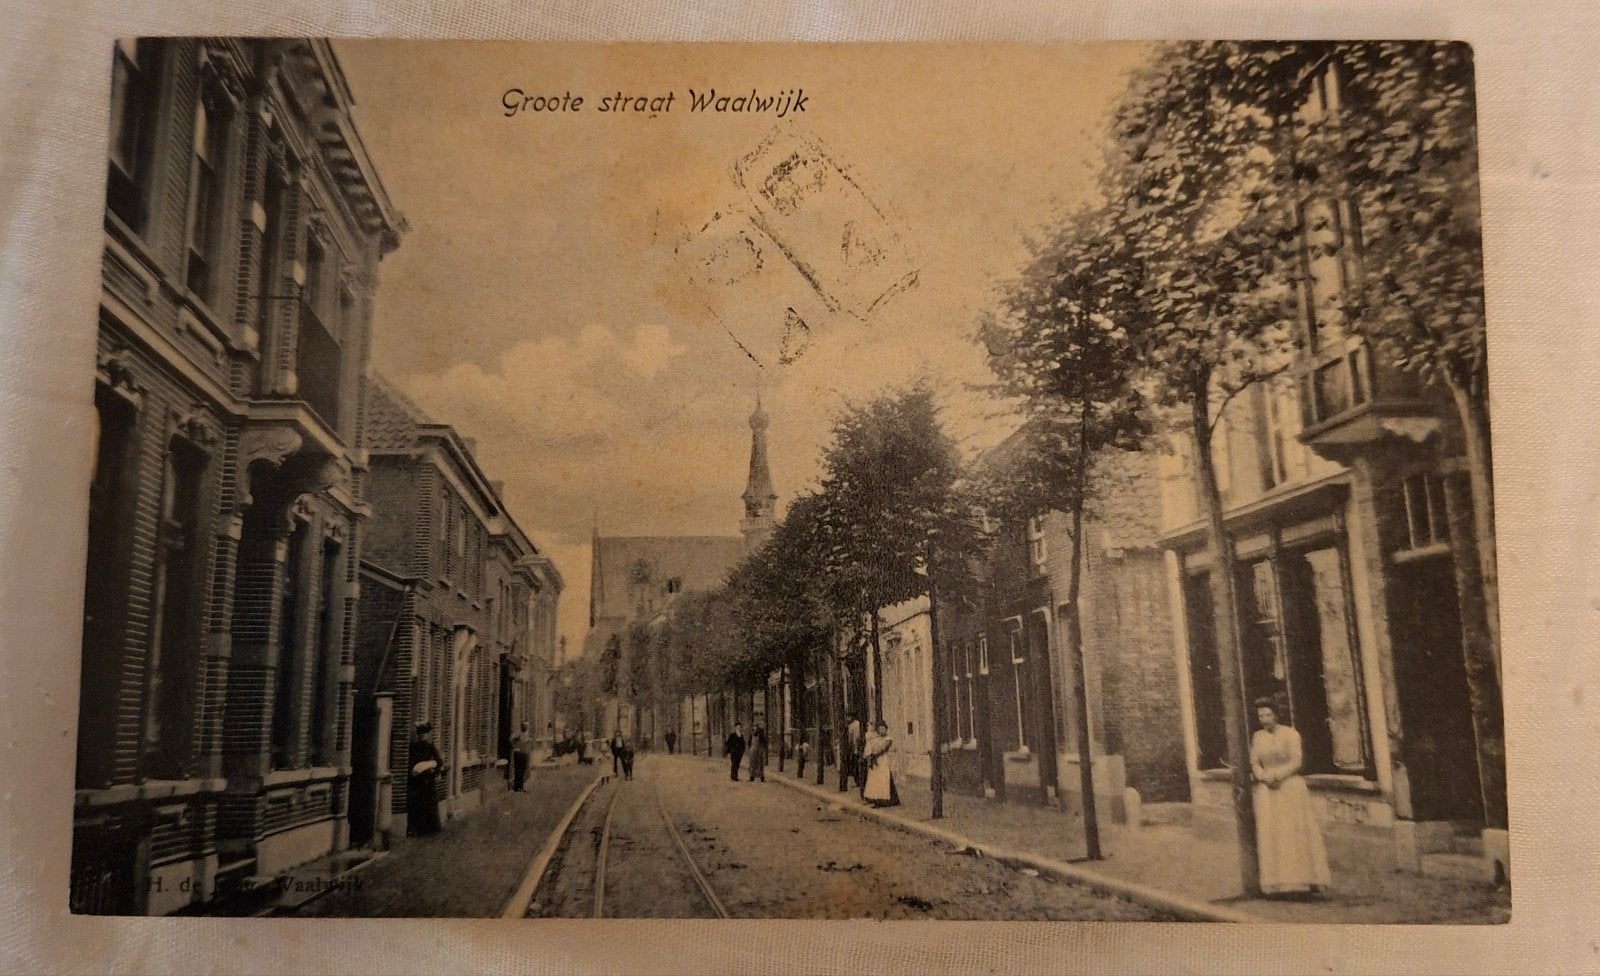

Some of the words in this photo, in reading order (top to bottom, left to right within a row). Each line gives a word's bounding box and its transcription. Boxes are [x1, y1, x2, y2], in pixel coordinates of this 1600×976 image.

[502, 88, 584, 117] Groote
[598, 91, 676, 112] straat
[689, 88, 810, 118] Waalwijk
[180, 876, 201, 893] de
